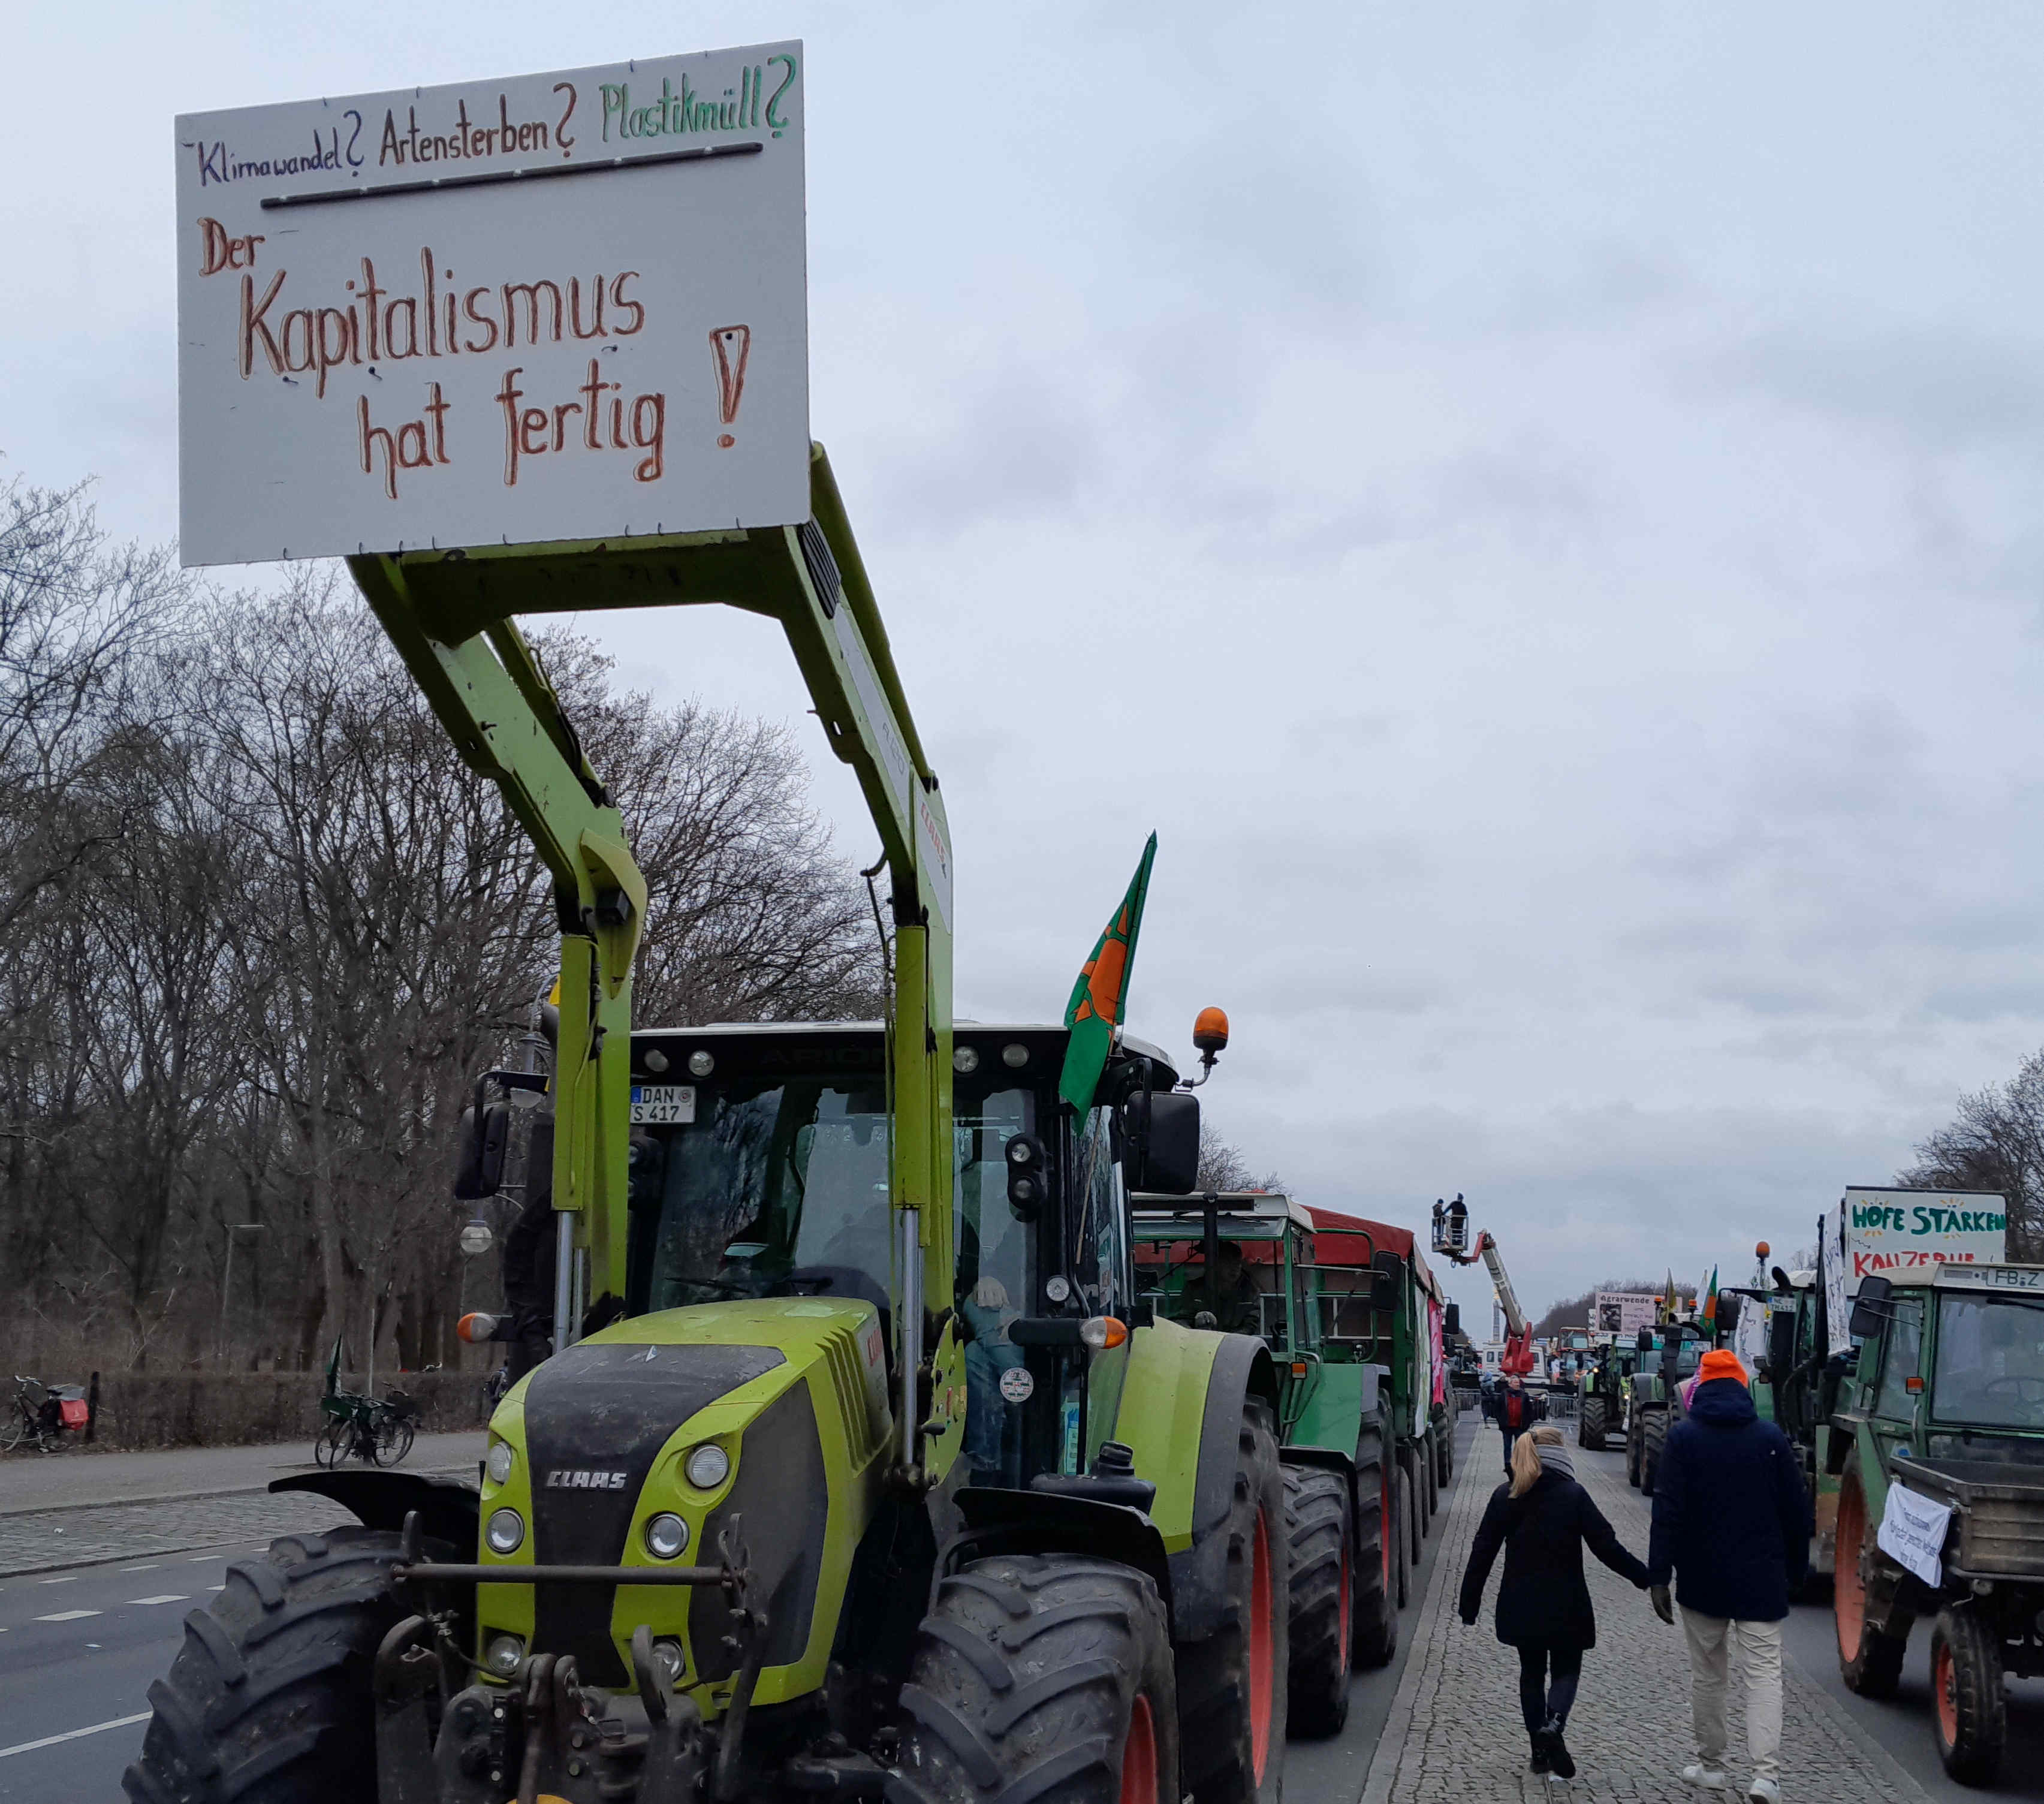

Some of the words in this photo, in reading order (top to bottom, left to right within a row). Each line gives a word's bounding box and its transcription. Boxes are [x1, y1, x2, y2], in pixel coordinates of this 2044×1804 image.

[197, 110, 364, 186] Klimawandel?
[378, 82, 577, 166] Artensterben?
[599, 53, 797, 144] Plastikmüll?
[196, 217, 265, 276] Der
[238, 246, 646, 399] Kapitalismus
[358, 381, 451, 499] hat
[496, 357, 665, 486] fertig
[634, 1106, 643, 1121] S
[649, 1106, 680, 1121] 417
[643, 1088, 674, 1104] DAN
[1852, 1201, 1905, 1232] HÖFE
[1910, 1204, 2006, 1236] STÄRKEN
[545, 1471, 628, 1489] CLAAS
